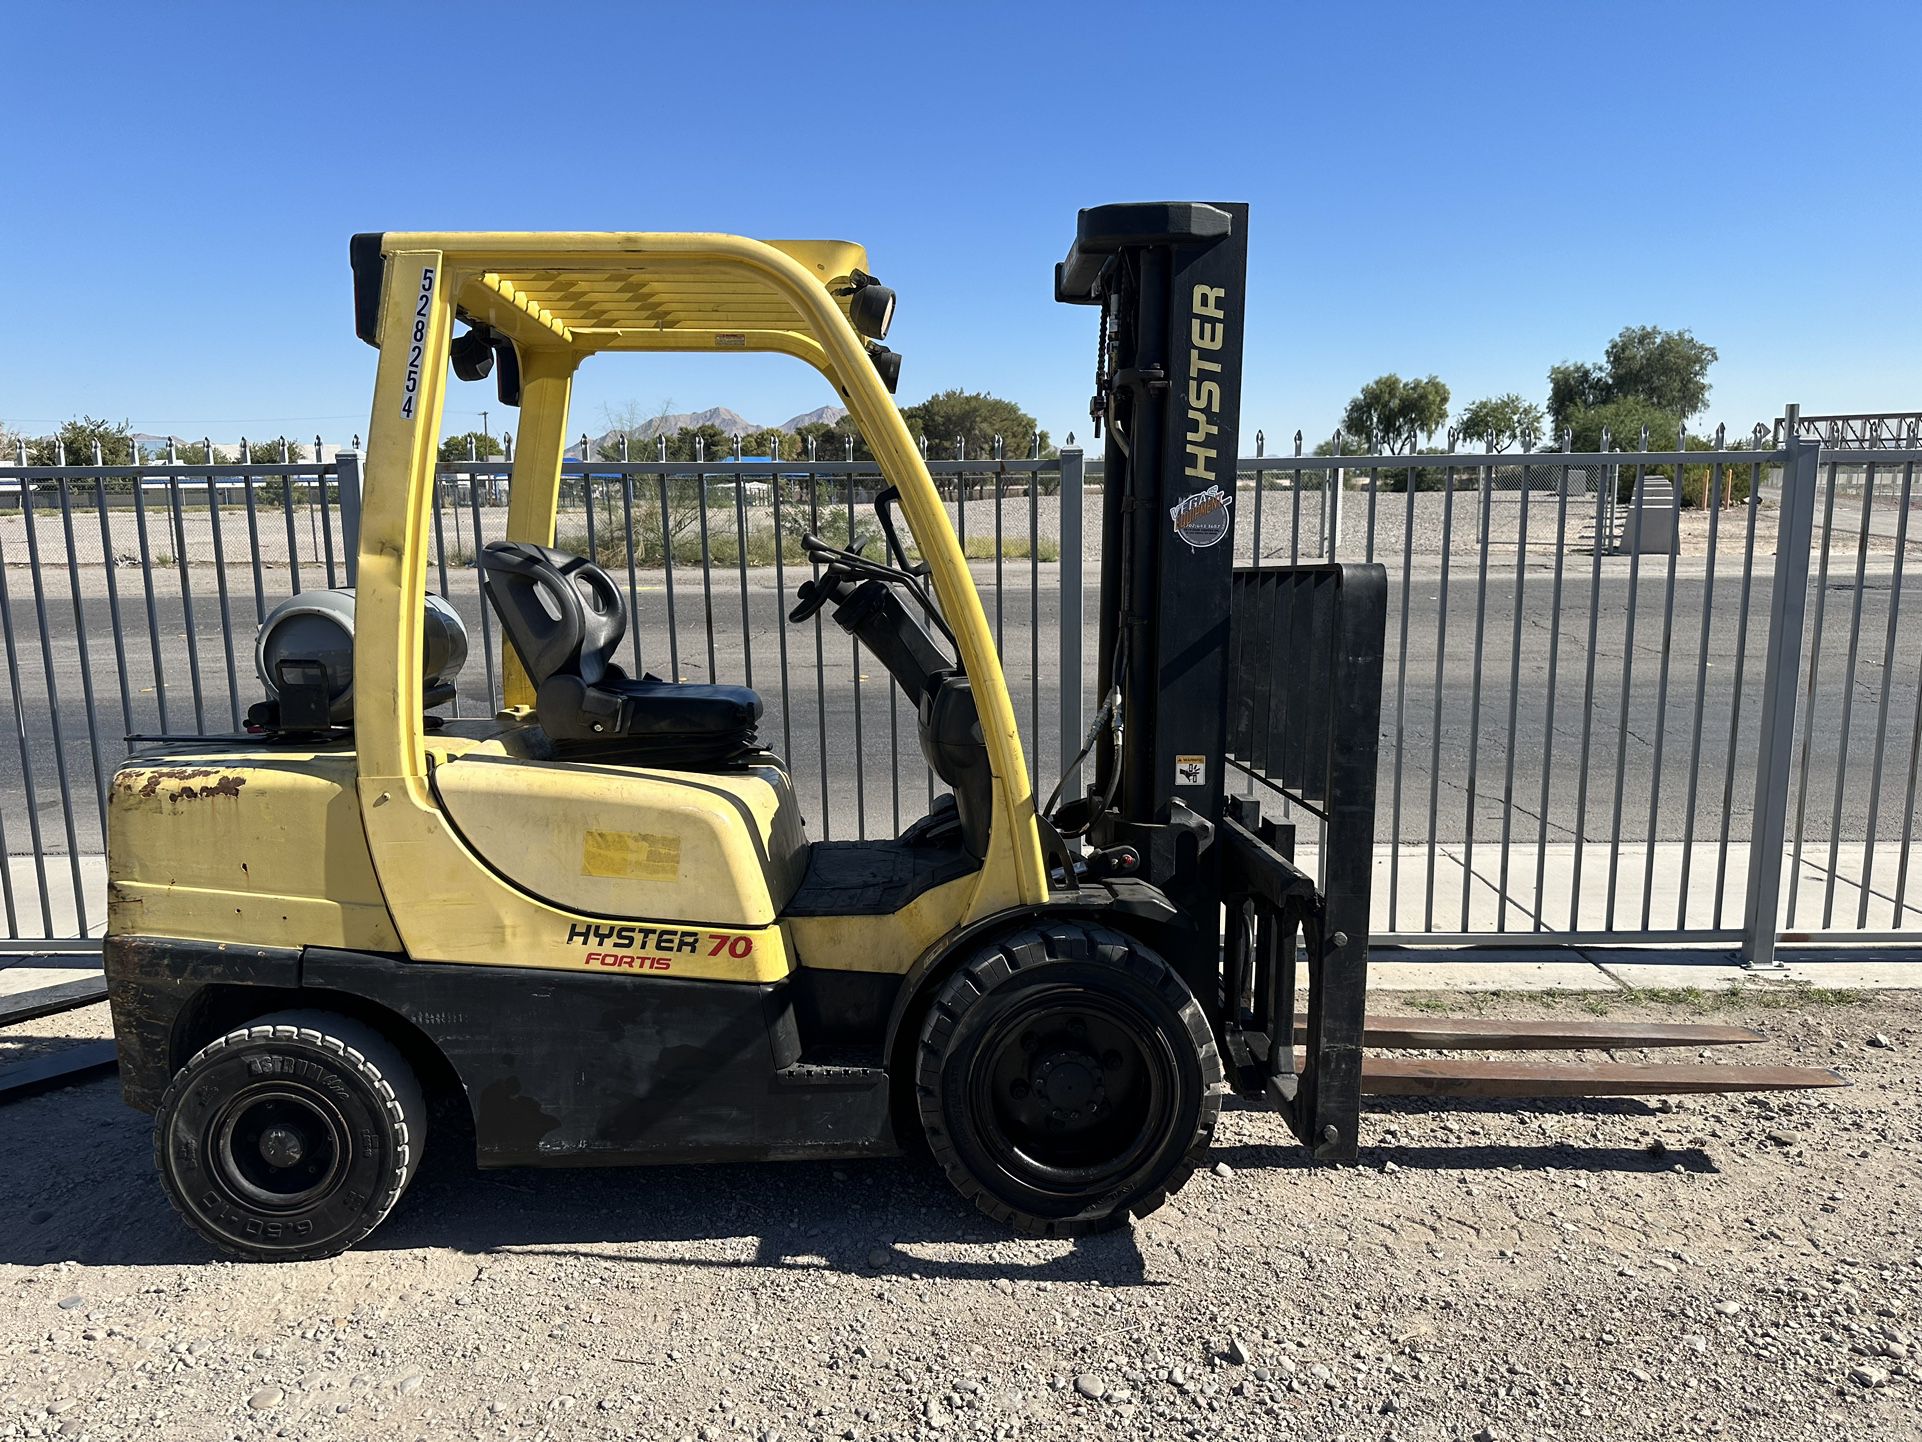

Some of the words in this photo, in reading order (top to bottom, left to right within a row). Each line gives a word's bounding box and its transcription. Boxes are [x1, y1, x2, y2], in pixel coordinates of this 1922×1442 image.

[402, 268, 434, 418] 528254
[1184, 283, 1225, 481] HYSTER
[1170, 485, 1218, 520] VEGAS
[566, 923, 699, 954] HYSTER
[707, 934, 753, 959] 70
[584, 952, 672, 970] FORTIS
